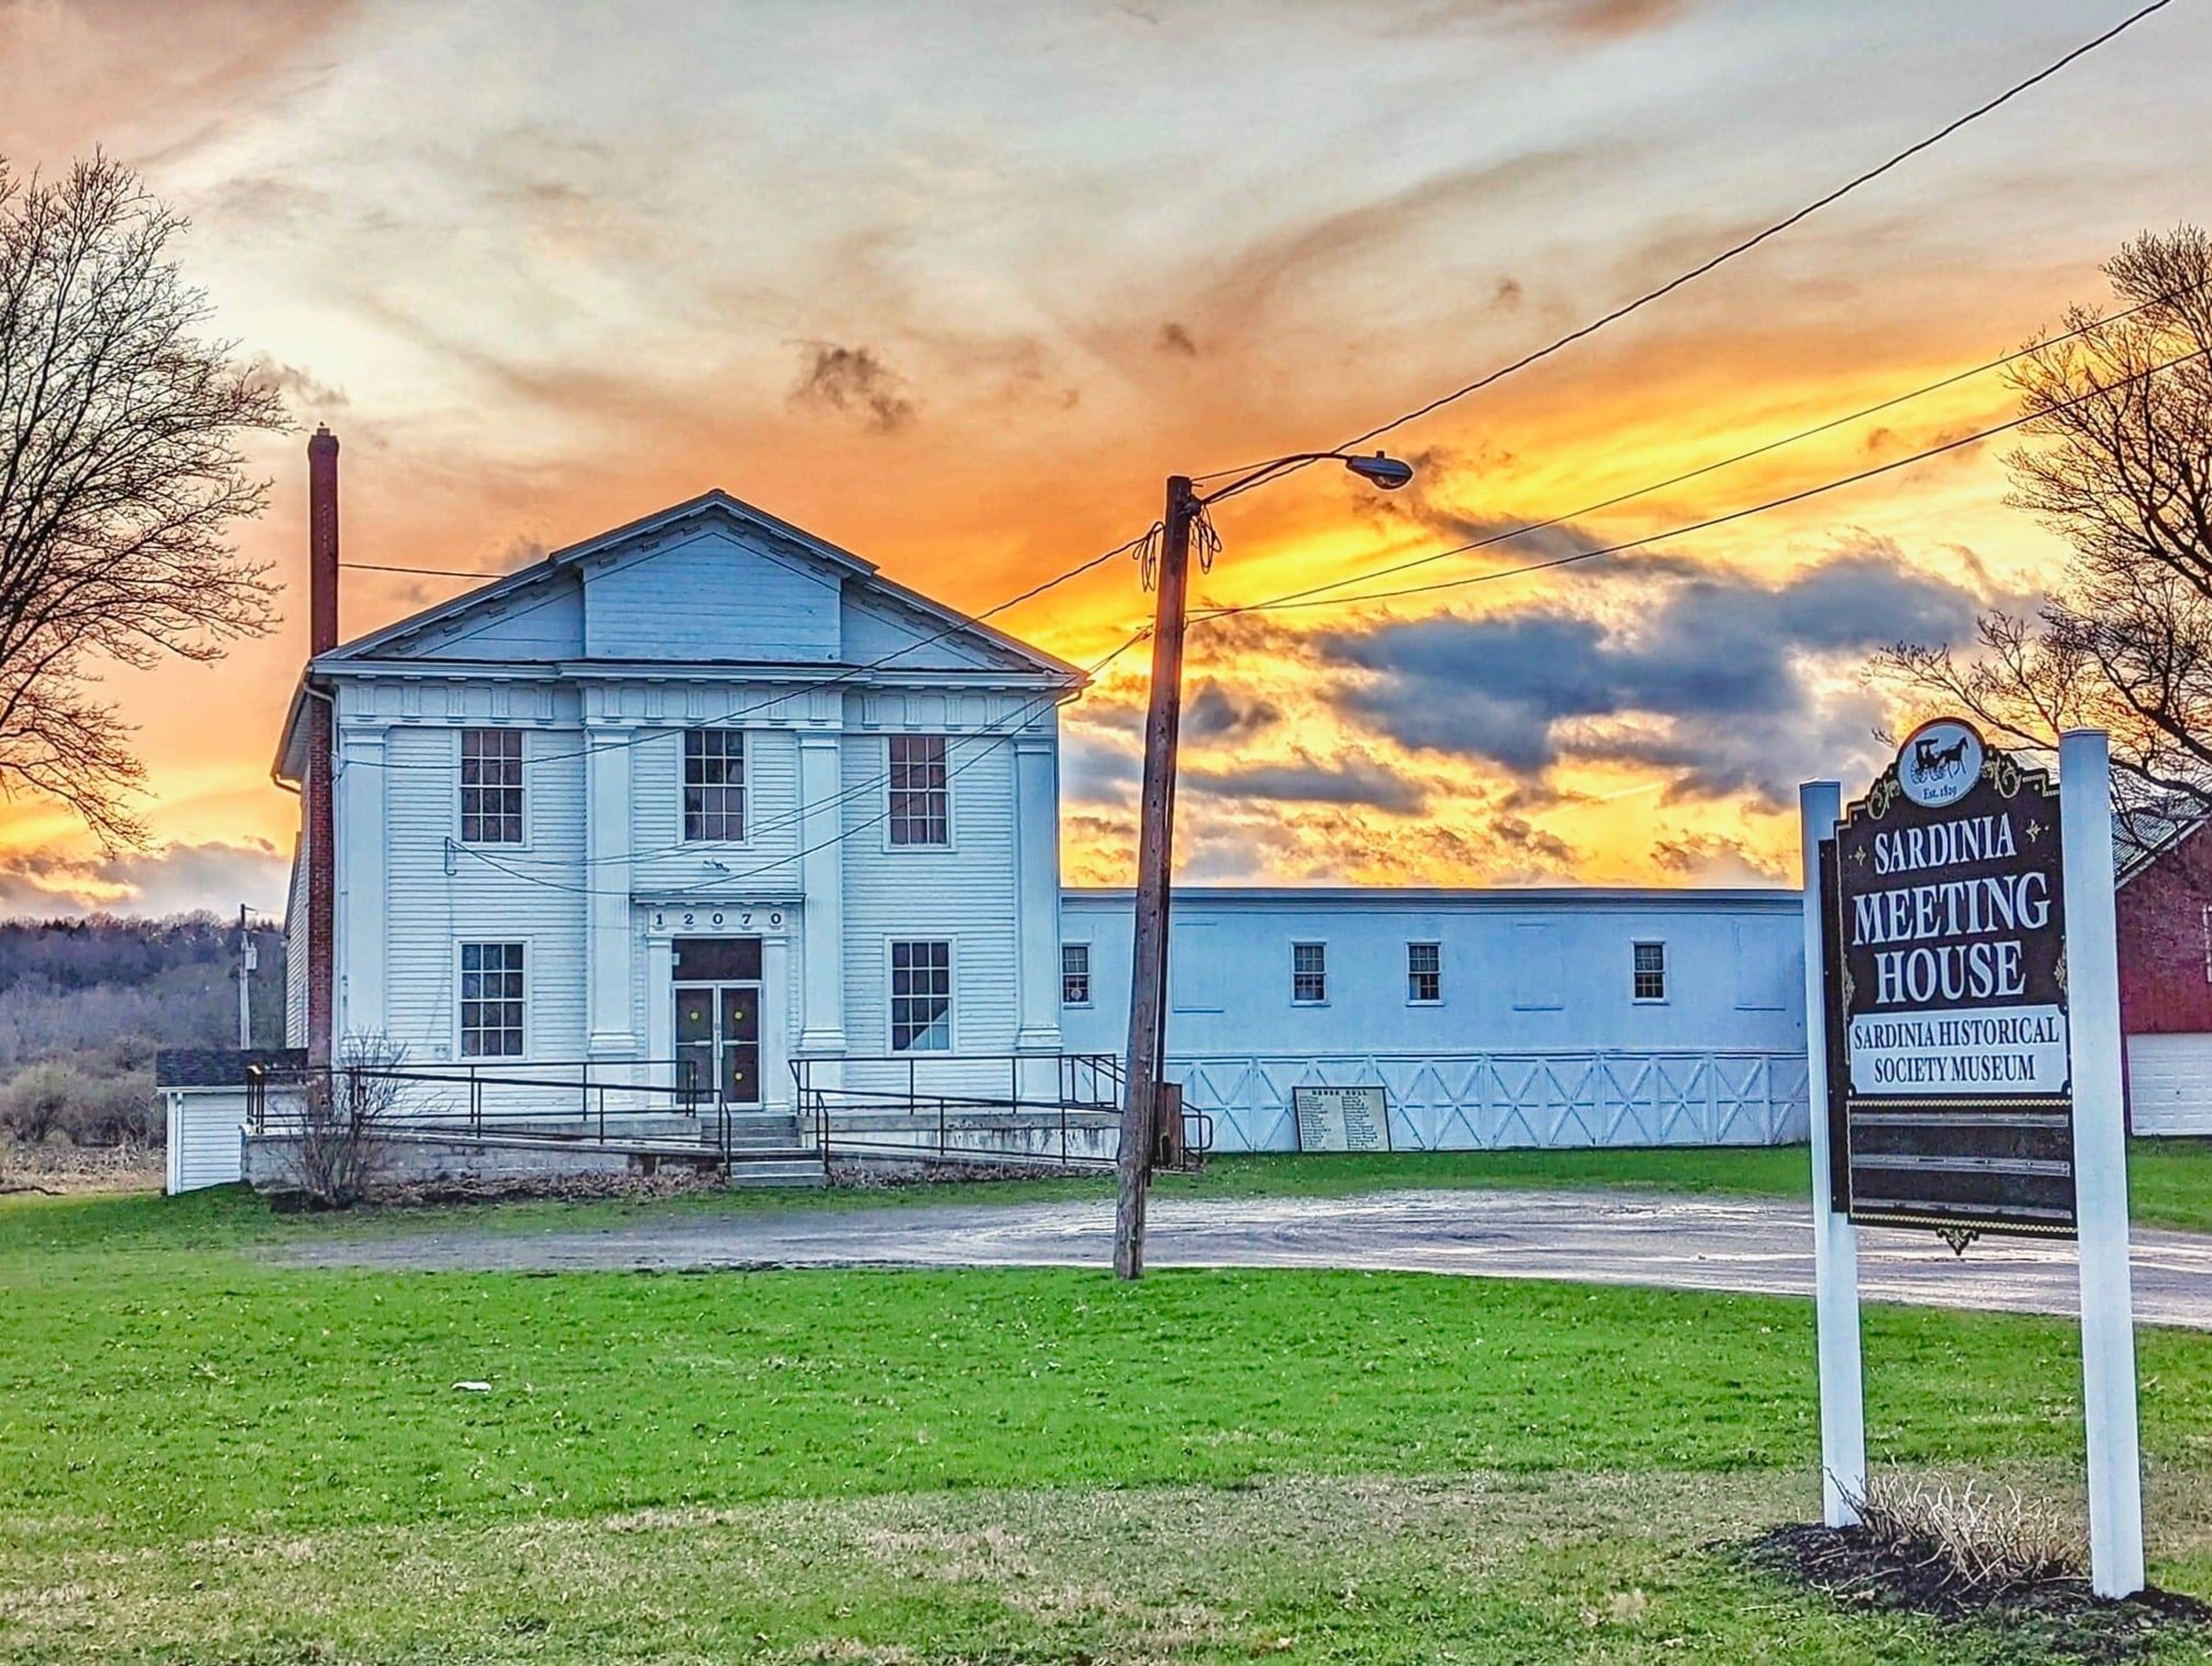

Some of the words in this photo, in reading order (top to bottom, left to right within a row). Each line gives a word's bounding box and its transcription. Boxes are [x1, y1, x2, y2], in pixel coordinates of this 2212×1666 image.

[1923, 788, 1939, 800] Est.
[1874, 812, 2016, 874] SARDINIA
[656, 913, 782, 925] 12070
[1851, 872, 2051, 945] MEETING
[1874, 940, 2026, 1004] HOUSE
[1854, 1024, 1937, 1050] SARDINIA
[1938, 1016, 2059, 1046] HISTORICAL
[1874, 1058, 1948, 1083] SOCIETY
[1950, 1054, 2036, 1081] MUSEUM
